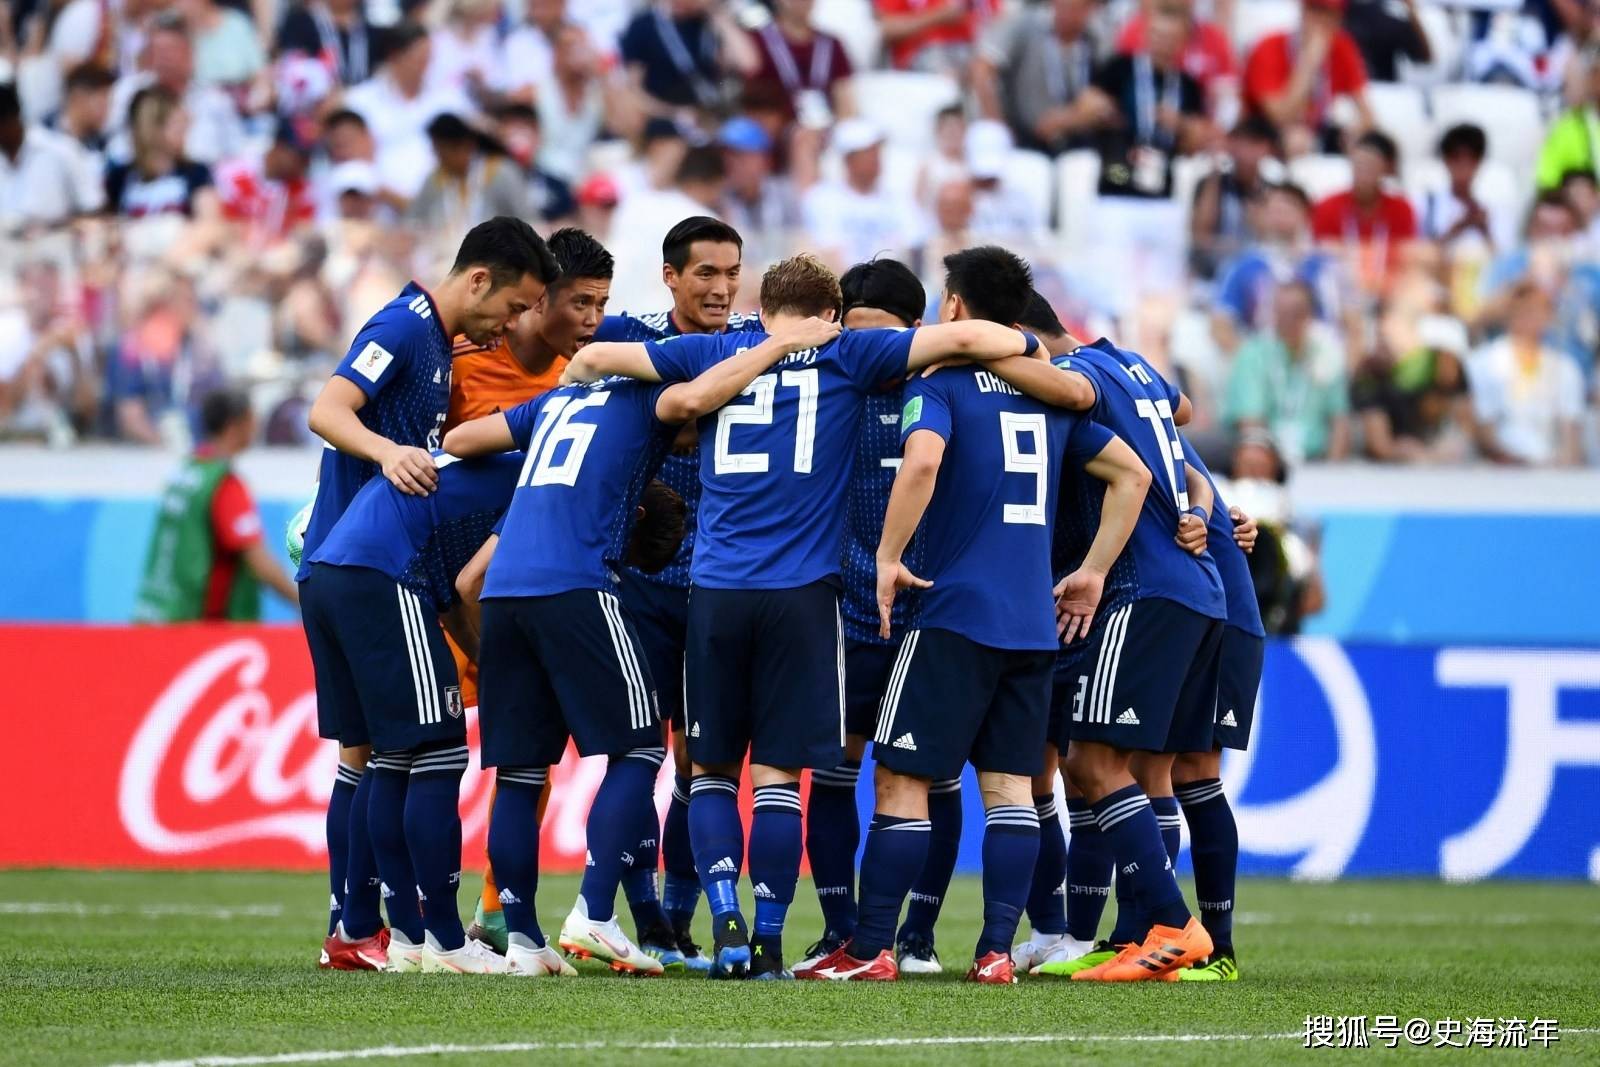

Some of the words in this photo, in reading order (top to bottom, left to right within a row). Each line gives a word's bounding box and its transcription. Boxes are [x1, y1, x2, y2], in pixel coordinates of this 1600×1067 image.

[516, 390, 612, 489] 16
[999, 411, 1049, 526] 9
[815, 885, 848, 897] APAN
[910, 891, 939, 906] APAN
[1199, 899, 1231, 911] APAN
